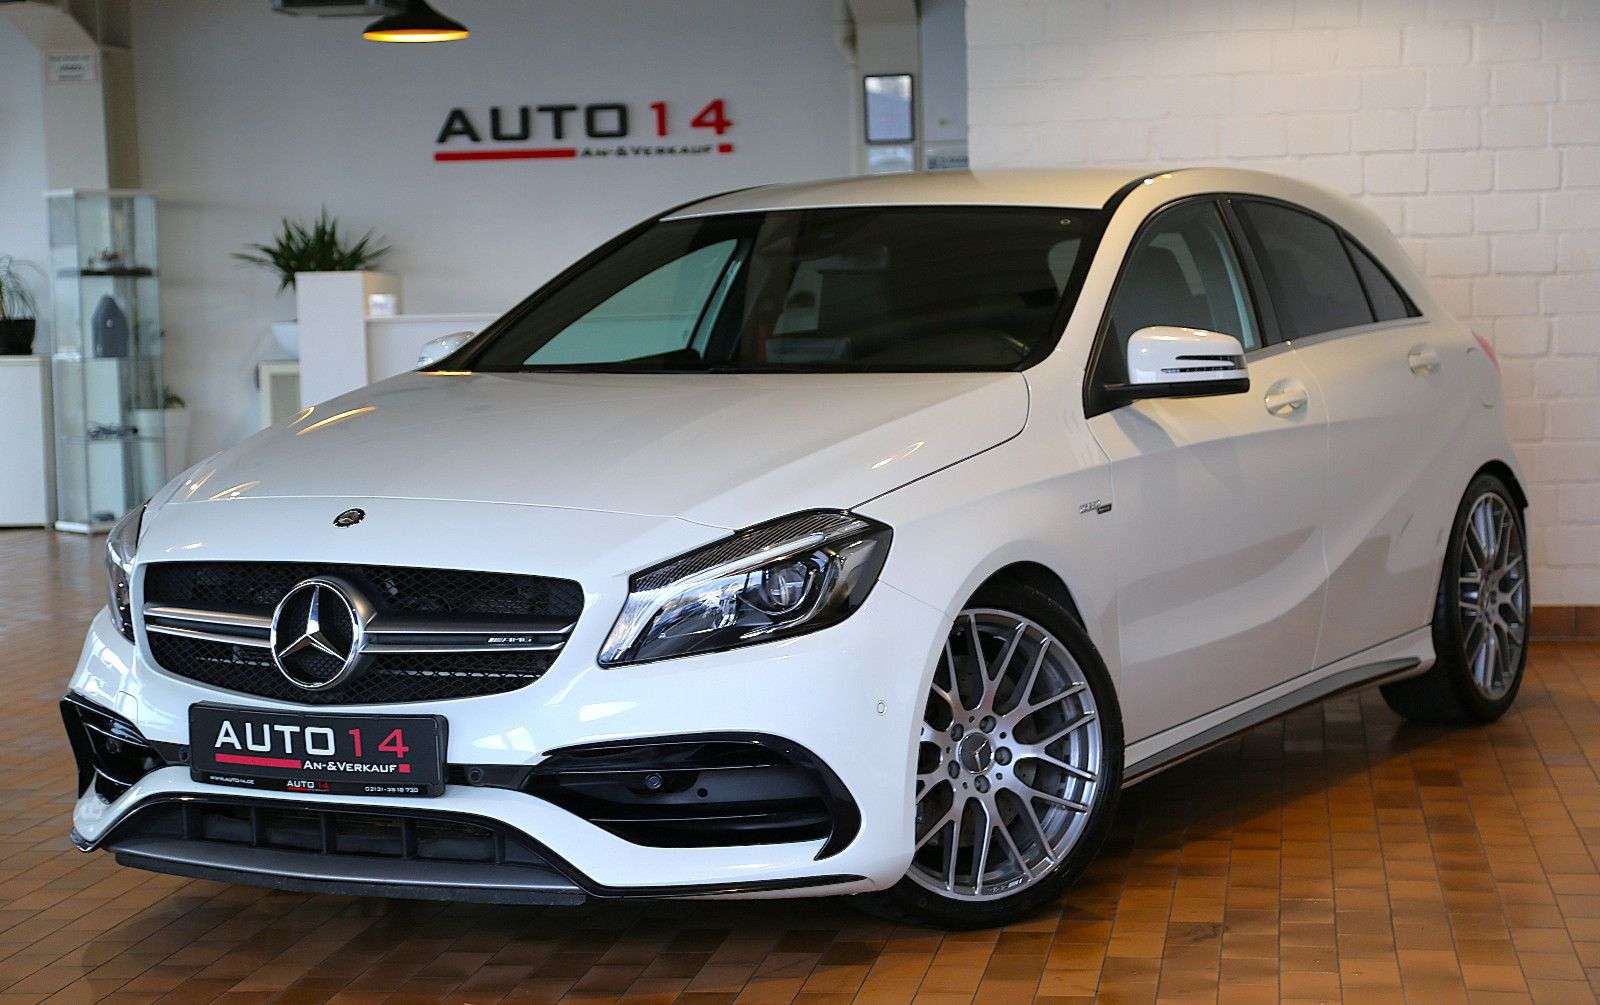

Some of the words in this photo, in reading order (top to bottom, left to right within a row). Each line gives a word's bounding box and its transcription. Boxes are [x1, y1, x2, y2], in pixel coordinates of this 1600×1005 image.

[436, 103, 629, 143] AUTO
[650, 98, 734, 137] 14
[214, 720, 336, 756] AUTO
[347, 728, 410, 759] 14
[287, 780, 315, 789] AUTO
